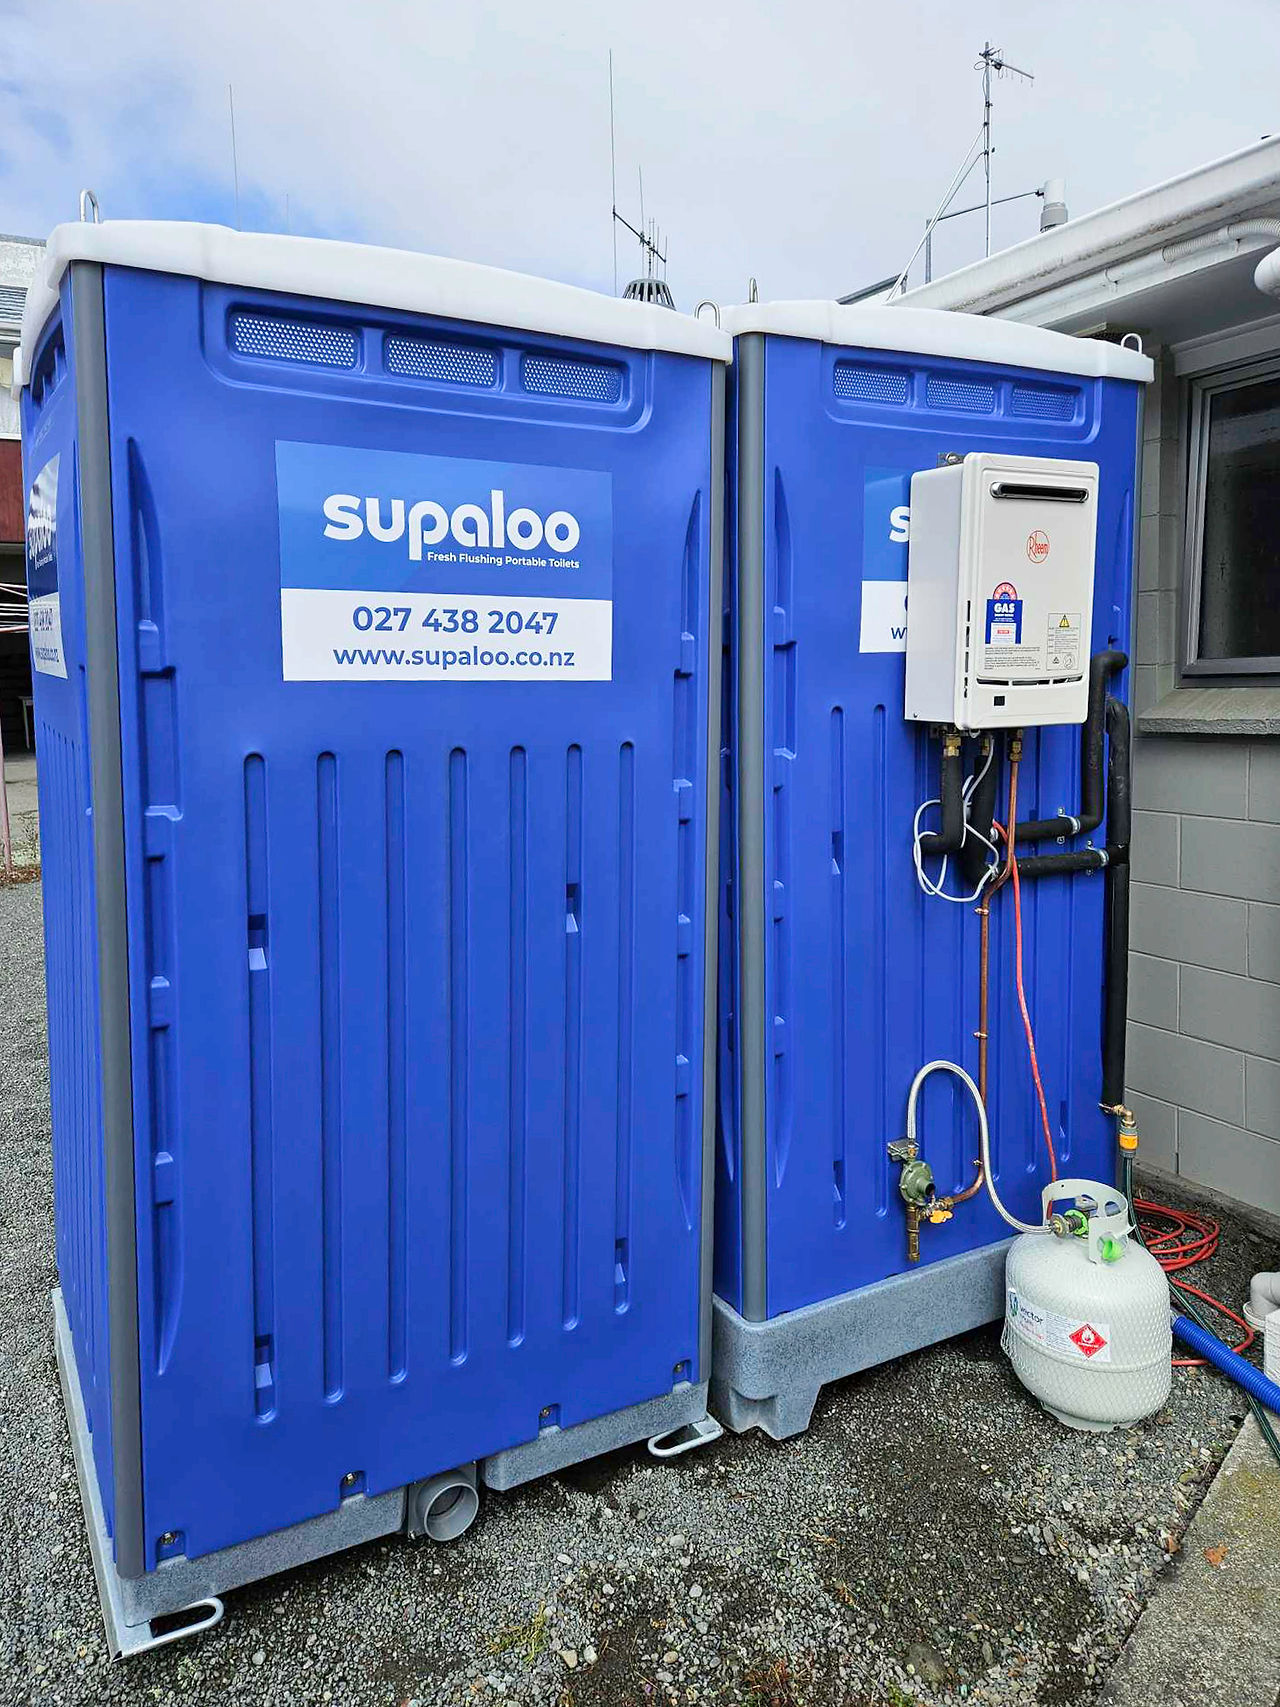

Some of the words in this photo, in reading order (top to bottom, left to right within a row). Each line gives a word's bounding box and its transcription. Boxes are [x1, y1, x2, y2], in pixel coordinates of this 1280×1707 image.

[323, 489, 580, 561] supaloo
[1028, 532, 1049, 559] Rheem
[427, 551, 457, 563] Fresh
[459, 553, 503, 567] Flushing
[505, 555, 547, 568] Portable
[549, 557, 580, 569] Toilets
[353, 606, 412, 632] 027
[422, 608, 479, 634] 438
[488, 610, 559, 635] 2047
[994, 602, 1015, 614] GAS
[333, 646, 575, 671] www.supaloo.co.nz
